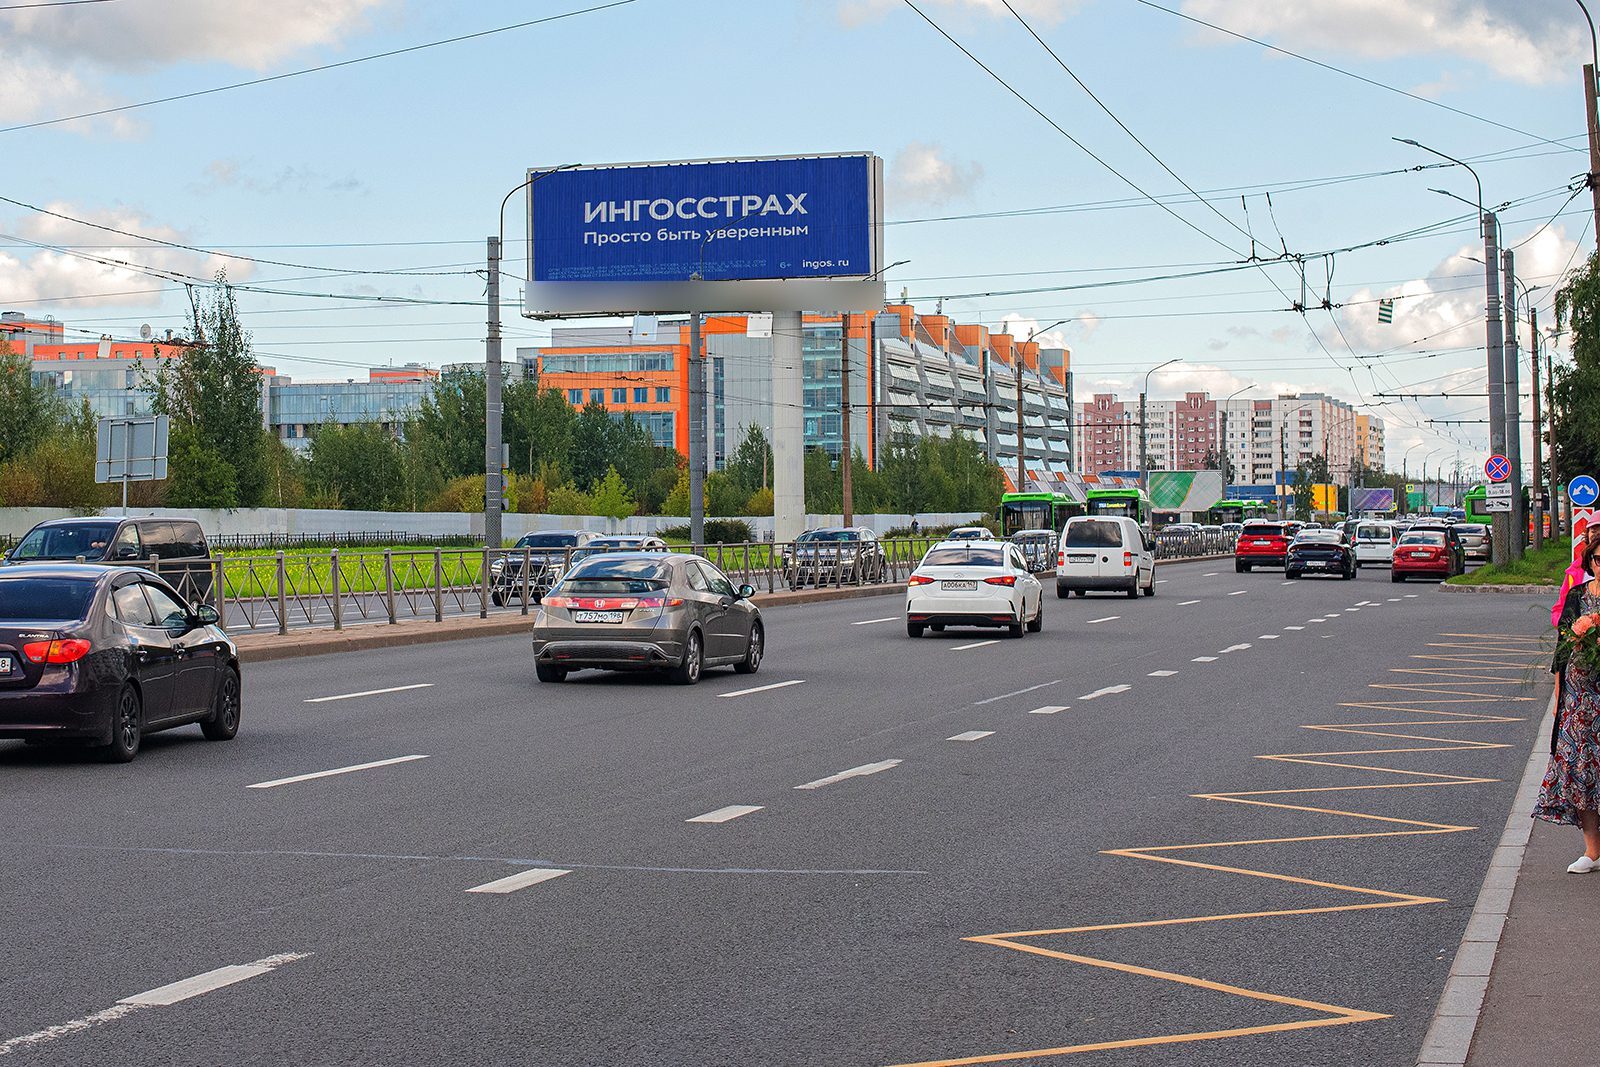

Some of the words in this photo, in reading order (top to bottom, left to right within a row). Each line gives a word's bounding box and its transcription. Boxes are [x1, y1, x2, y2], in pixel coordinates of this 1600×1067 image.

[584, 193, 808, 223] ИНГОССТРАХ
[583, 231, 652, 247] Просто
[657, 228, 701, 241] быть
[706, 225, 808, 242] уверенным
